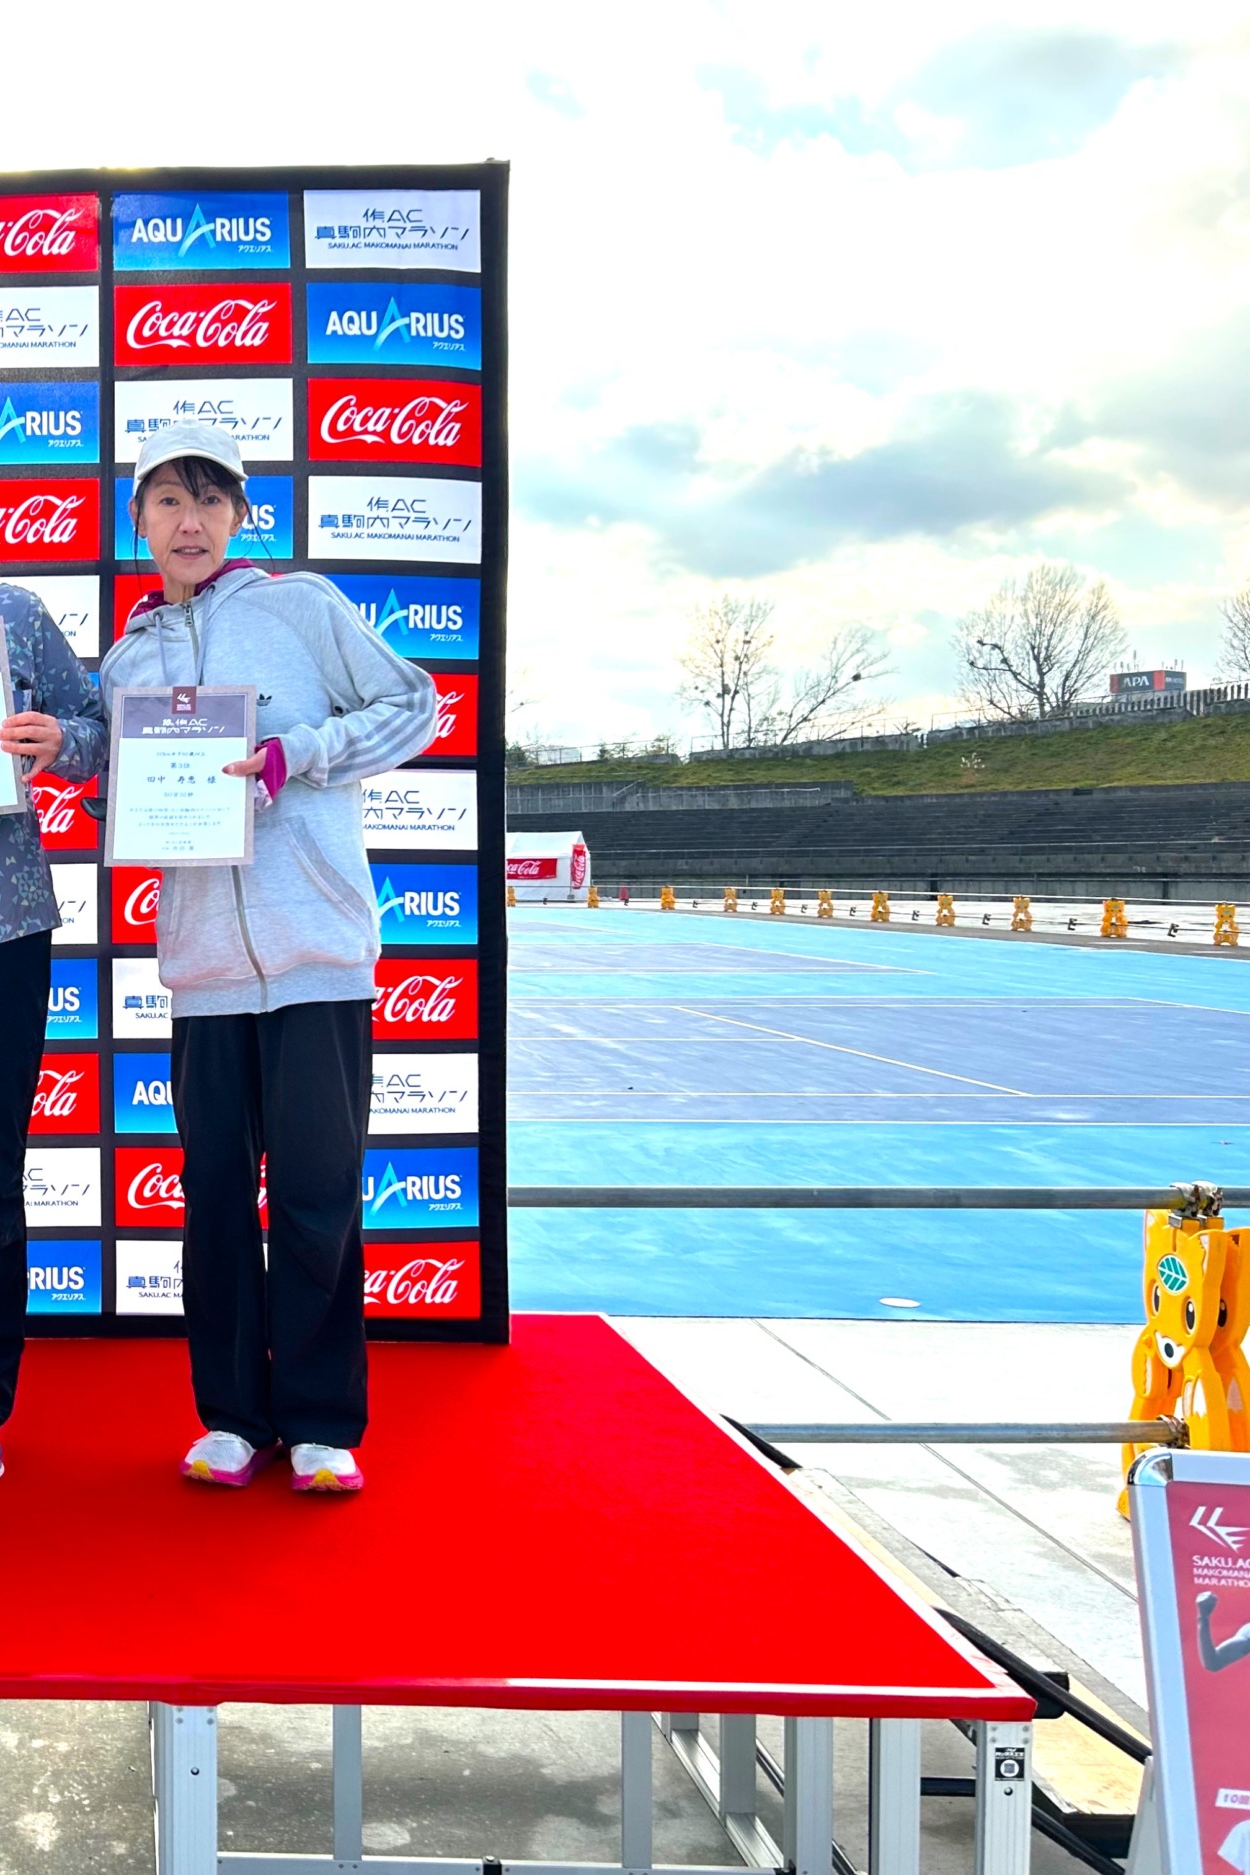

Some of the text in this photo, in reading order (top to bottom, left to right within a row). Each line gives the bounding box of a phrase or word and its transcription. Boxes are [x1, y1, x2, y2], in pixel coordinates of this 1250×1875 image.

[130, 204, 271, 257] AQUARIUS
[314, 224, 469, 241] 真駒内マラソン
[239, 244, 272, 252] アクエリアス
[363, 241, 412, 249] MAKOMANAI
[412, 241, 458, 250] MARATHON
[126, 299, 277, 349] Coca-Cola
[326, 297, 464, 353] AQUARIUS
[432, 342, 466, 350] アクエリアス
[124, 416, 282, 434] 真駒マラソン
[320, 394, 468, 446] Coca-Cola
[47, 438, 82, 447] アクエリアス
[318, 513, 472, 532] 真駒内マラソン
[366, 532, 414, 540] MAKOMANAI
[415, 534, 460, 542] MARATHON
[358, 588, 462, 636] UARIUS
[430, 633, 461, 641] アクエリアス
[1123, 676, 1150, 687] APA
[362, 806, 467, 820] 内マラソン
[507, 860, 542, 875] ca-Cola
[378, 876, 459, 923] ARIUS
[427, 919, 460, 927] アクエリアス
[374, 975, 464, 1022] -Cola
[371, 1088, 468, 1103] 内マラソン
[362, 1161, 461, 1216] UARIUS
[428, 1202, 462, 1211] アクエリアス
[31, 1266, 84, 1290] RIUS
[363, 1258, 464, 1304] a-Cola
[51, 1292, 85, 1301] アクエリアス
[1193, 1567, 1250, 1578] MAKOMAN
[1194, 1576, 1250, 1588] MARATHO
